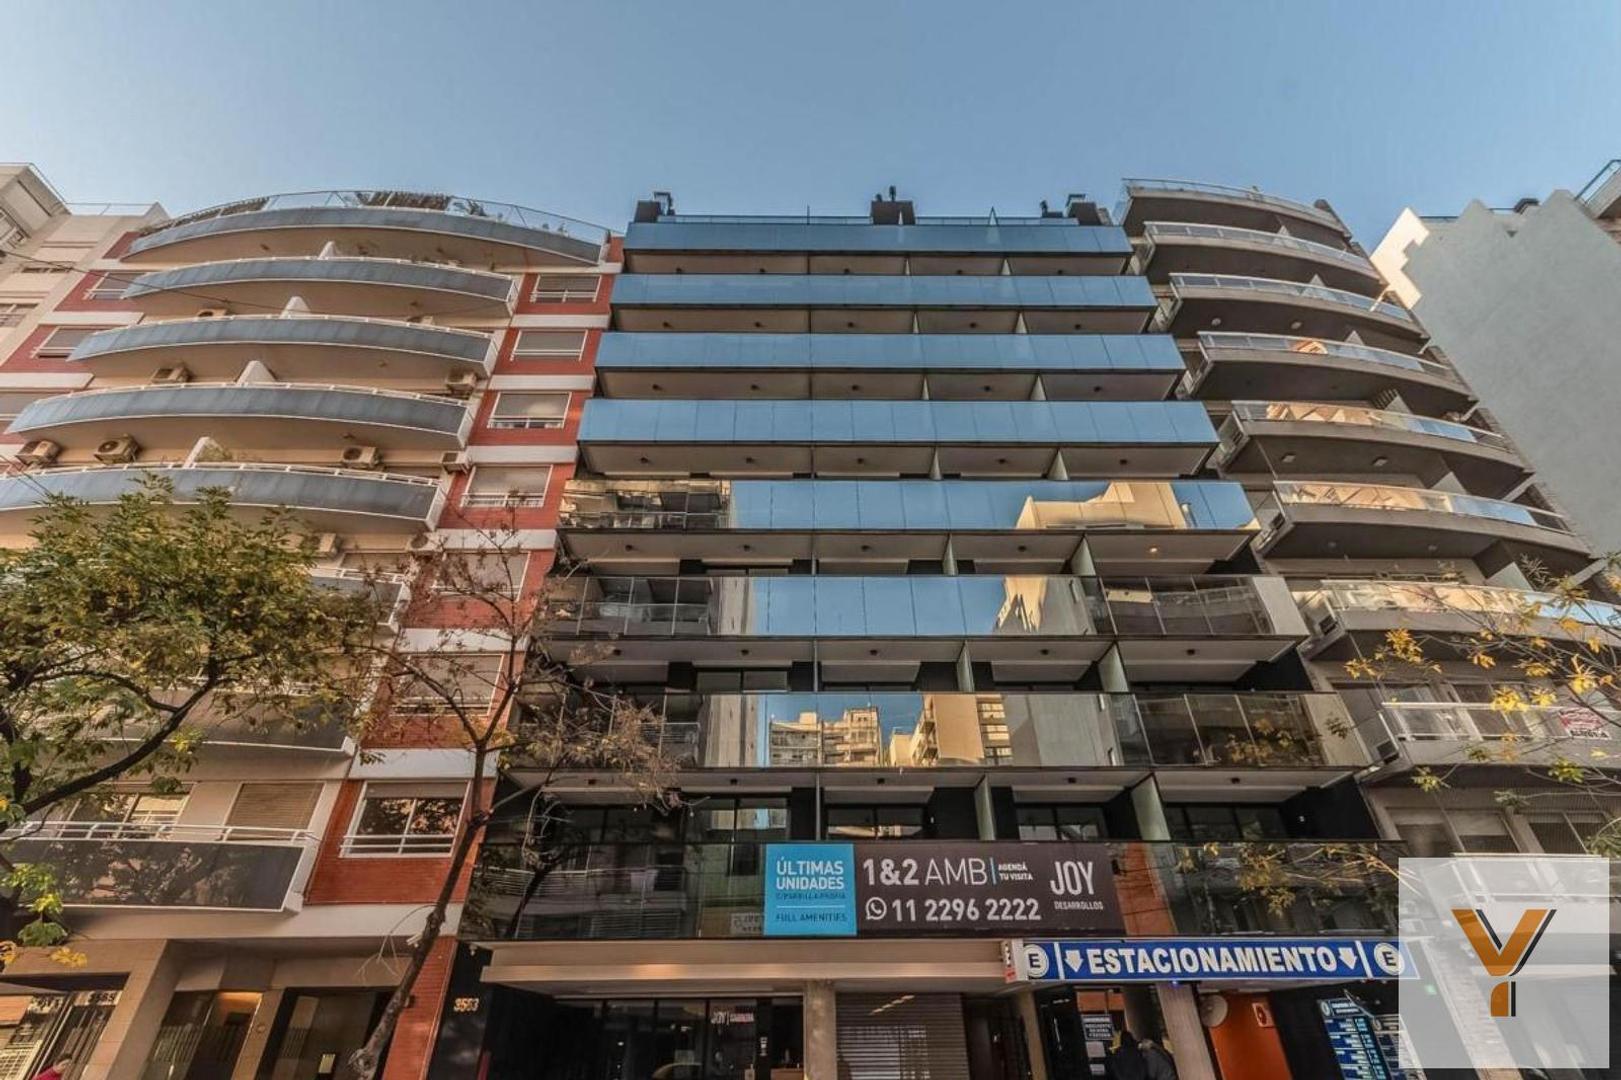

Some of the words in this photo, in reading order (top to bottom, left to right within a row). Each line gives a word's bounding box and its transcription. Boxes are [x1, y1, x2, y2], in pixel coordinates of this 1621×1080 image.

[776, 856, 844, 876] ÚLTIMAS
[863, 858, 919, 887] 1&2
[925, 857, 987, 886] AMB
[776, 876, 845, 890] UNIDADES
[999, 873, 1009, 881] TU
[1010, 872, 1034, 881] VISITA
[1050, 860, 1095, 896] JOY
[891, 899, 917, 922] 11
[924, 898, 978, 922] 2296
[985, 898, 1042, 921] 2222
[1054, 901, 1104, 911] DESARROLLOS
[776, 912, 797, 922] FULL
[799, 912, 848, 922] AMENITIES
[1086, 947, 1338, 974] ESTACIONAMIENTO
